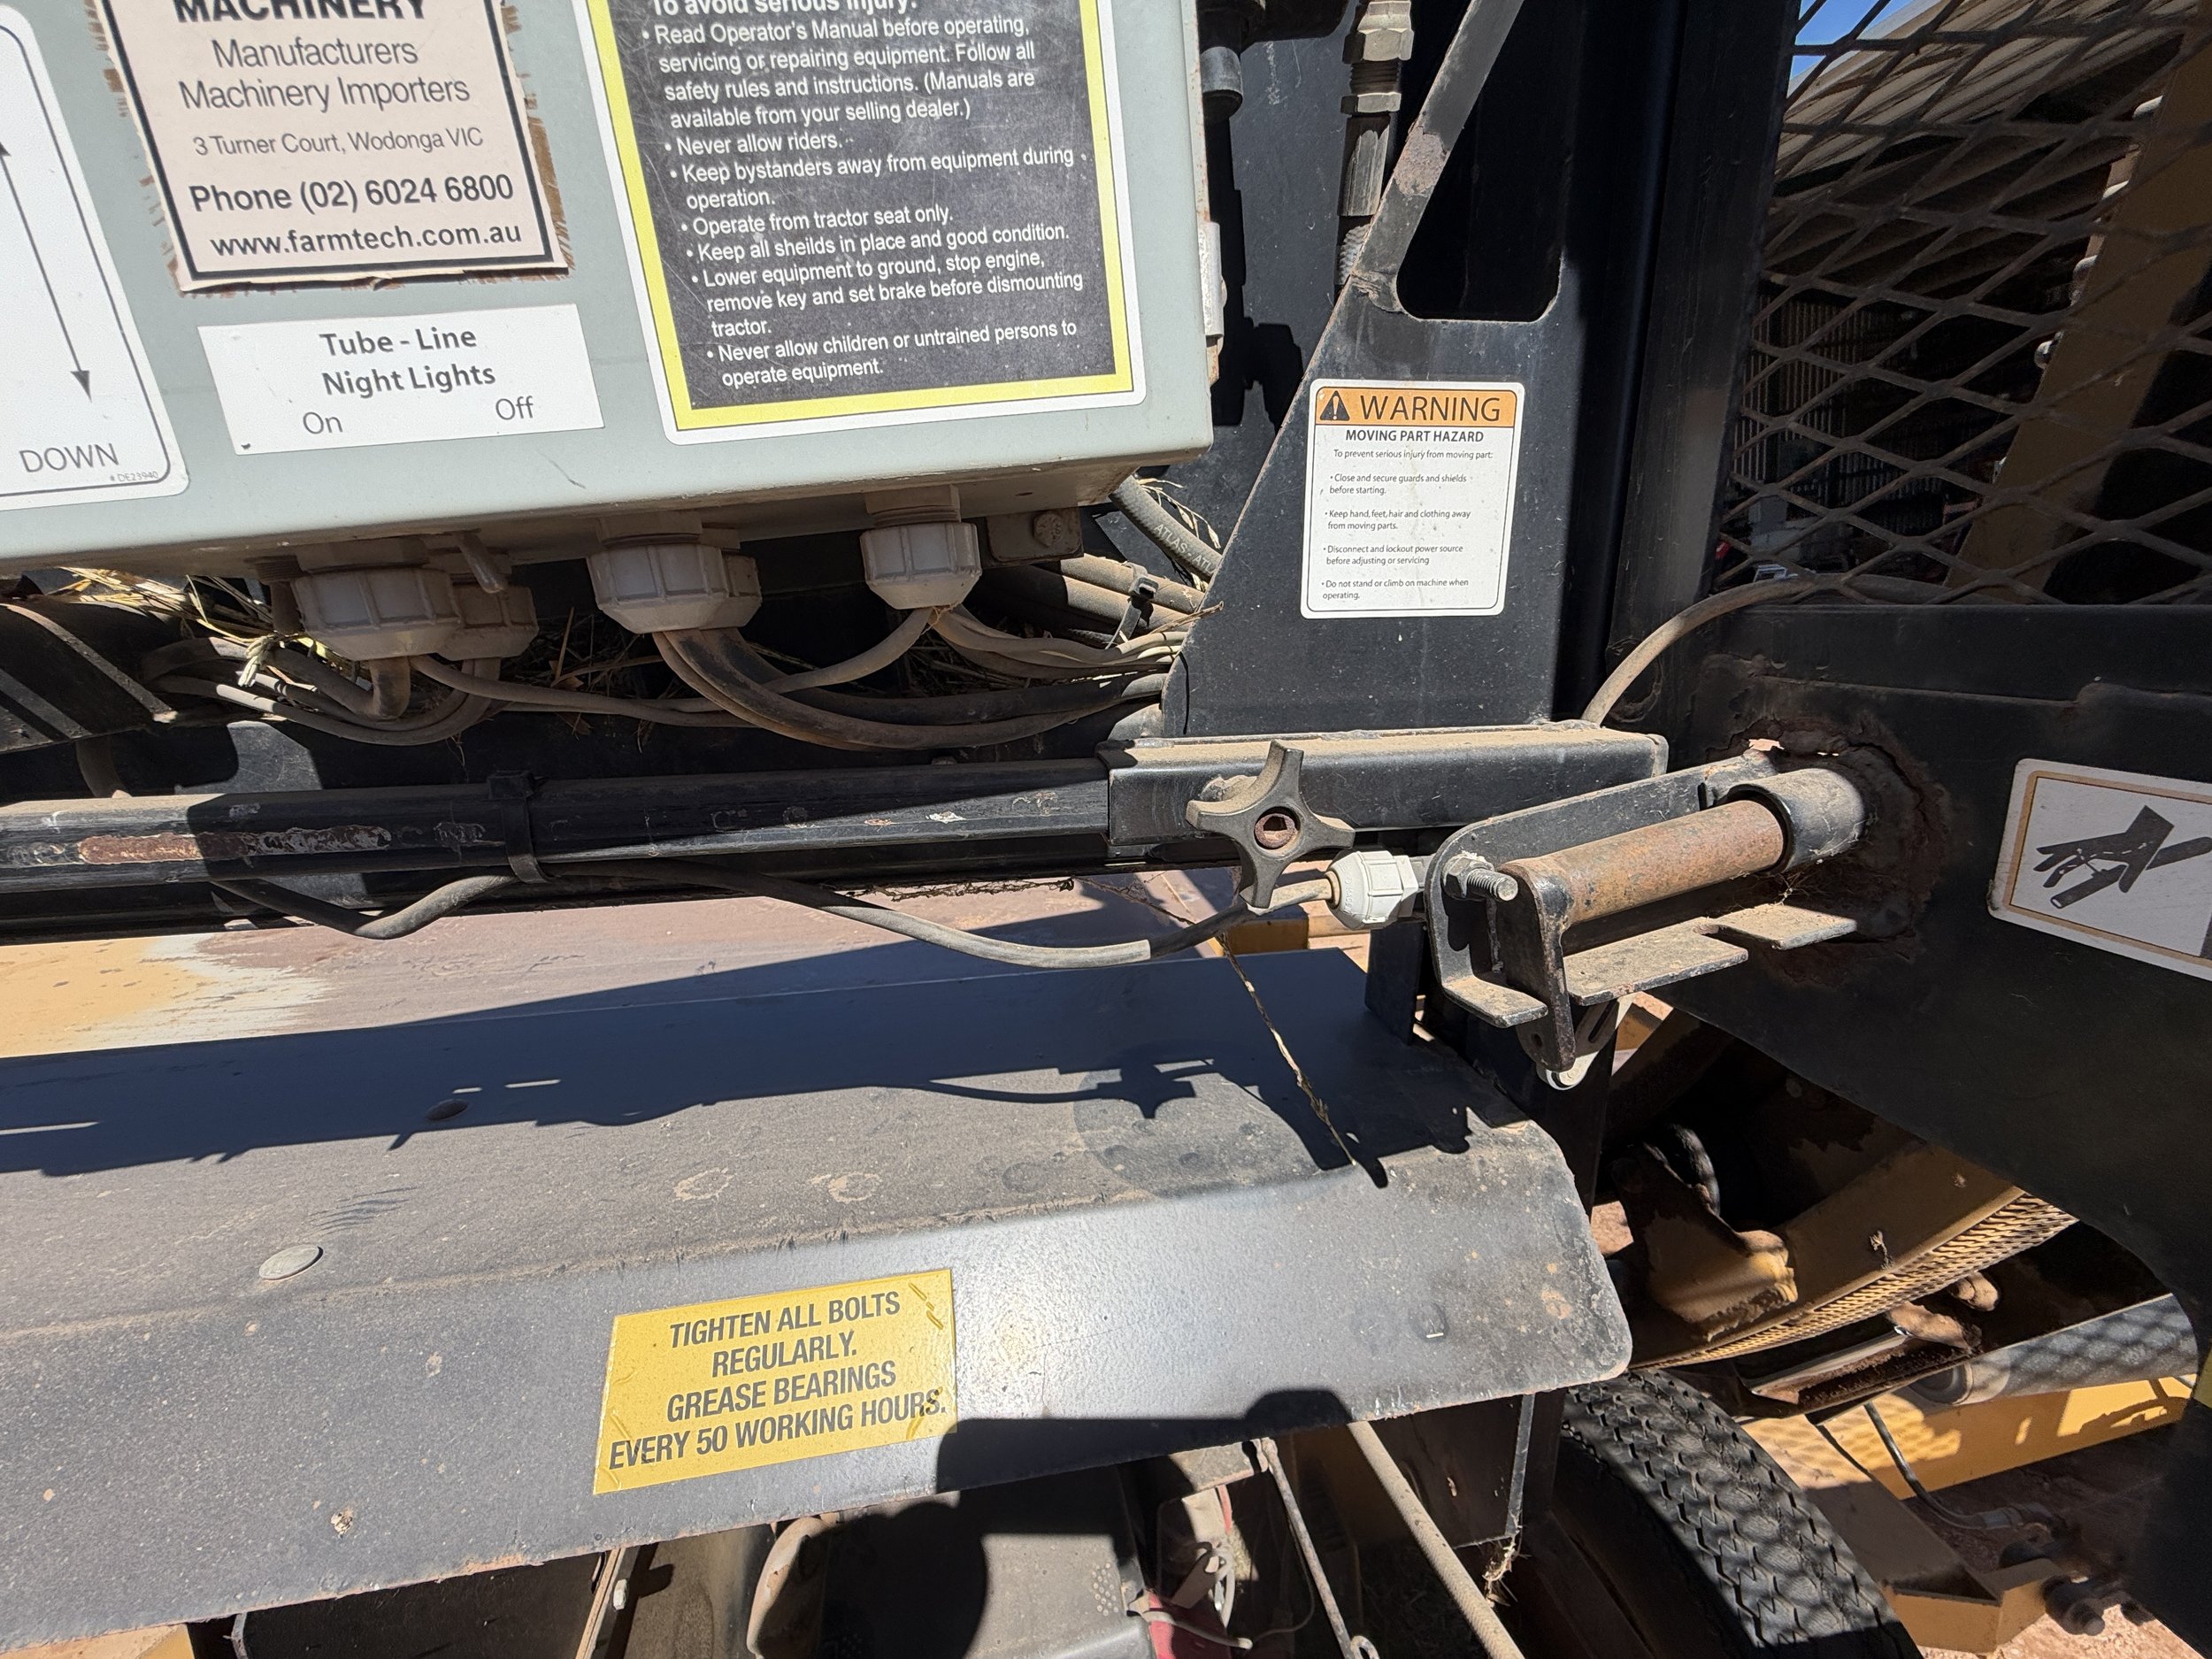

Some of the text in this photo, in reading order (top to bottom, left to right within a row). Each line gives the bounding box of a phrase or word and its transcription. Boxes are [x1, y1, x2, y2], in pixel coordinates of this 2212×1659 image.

[176, 0, 426, 23] MACHINERY
[685, 0, 749, 14] avoid
[754, 0, 841, 12] serious
[655, 23, 706, 44] Read
[710, 21, 809, 46] Operator's
[812, 18, 878, 39] Manual
[881, 16, 940, 37] before
[211, 35, 418, 67] Manufacturers
[658, 39, 1035, 76] servicing or repairing equipment. Follow all
[179, 76, 471, 113] Machinery Importers
[664, 69, 1035, 104] safety rules and instructions. (Manuals are
[671, 97, 970, 129] available from your selling dealer.)
[193, 127, 484, 156] 3 Turner Court, Wodonga VIC
[676, 131, 842, 156] Never allow riders.
[681, 145, 1074, 184] Keep bystanders away from equipment during
[189, 173, 513, 214] Phone (02) 6024 6800
[687, 188, 775, 212] operation.
[692, 214, 766, 239] Operate
[768, 212, 810, 230] from
[814, 209, 869, 228] tractor
[874, 205, 911, 225] seat
[211, 225, 522, 257] www.farmtech.com.au
[697, 242, 745, 264] Keep
[750, 239, 770, 258] all
[775, 235, 835, 257] sheilds
[839, 234, 856, 253] in
[860, 234, 906, 257] place
[910, 228, 941, 248] and
[947, 225, 987, 250] good
[703, 269, 757, 287] Lower
[763, 260, 853, 287] equipment
[855, 260, 872, 278] to
[945, 253, 980, 274] stop
[706, 271, 1083, 313] remove key and set brake before dismounting
[319, 331, 393, 356] Tube
[416, 327, 476, 350] Line
[711, 319, 772, 338] tractor.
[718, 320, 1076, 363] Never allow children or untrained persons to
[322, 363, 495, 398] Night Lights
[722, 357, 883, 389] operate equipment.
[495, 395, 533, 421] Off
[1361, 395, 1501, 421] WARNING
[303, 412, 343, 435] On
[1345, 430, 1483, 442] MOVING PART HAZARD
[19, 442, 119, 472] DOWN
[1403, 449, 1425, 460] injury
[1426, 449, 1444, 458] from
[1446, 449, 1474, 460] moving
[1329, 485, 1354, 494] before
[1334, 472, 1356, 481] Close
[1398, 474, 1425, 485] guards
[1425, 474, 1440, 483] and
[1440, 474, 1467, 483] shields
[1327, 520, 1345, 529] from
[1377, 522, 1399, 531] parts.
[1329, 510, 1348, 518] Keep
[1350, 510, 1371, 518] hand,
[1389, 510, 1403, 518] hair
[1403, 510, 1419, 518] and
[1419, 510, 1451, 520] clothing
[1154, 524, 1187, 552] ATLAS
[1327, 545, 1368, 554] Disconnect
[1325, 556, 1350, 565] before
[1352, 556, 1386, 566] adjusting
[1396, 556, 1430, 566] servicing
[1352, 579, 1373, 588] stand
[1384, 579, 1403, 588] climb
[669, 1292, 901, 1348] TIGHTEN ALL BOLTS
[711, 1331, 856, 1379] REGULARLY.
[667, 1361, 895, 1423] GREASE BEARINGS
[609, 1387, 945, 1471] EVERY 50 WORKING HOURS.
